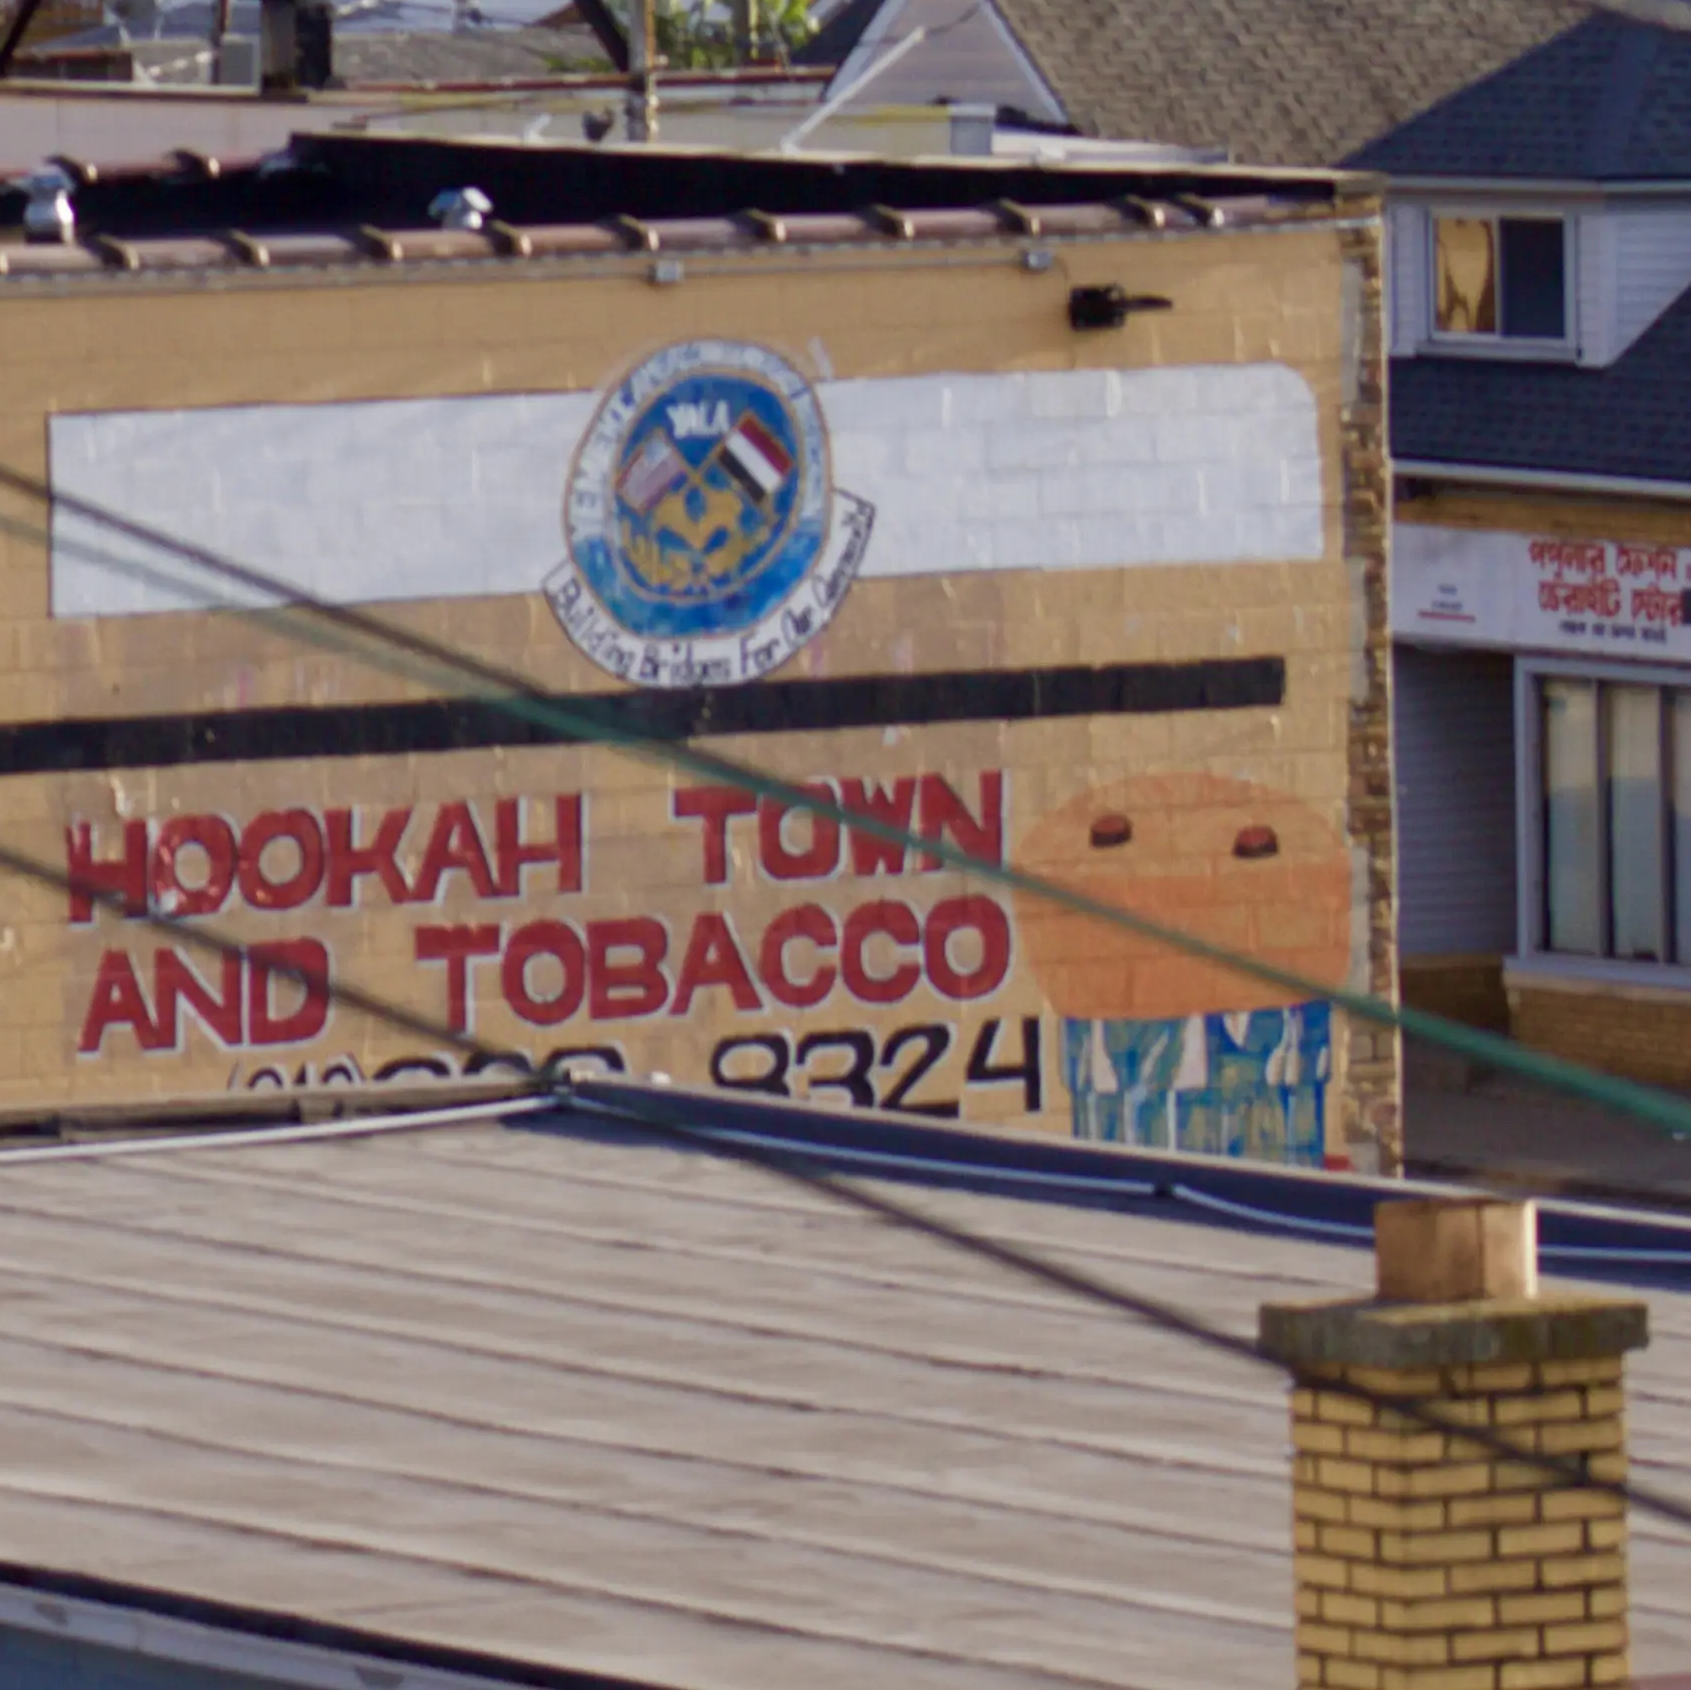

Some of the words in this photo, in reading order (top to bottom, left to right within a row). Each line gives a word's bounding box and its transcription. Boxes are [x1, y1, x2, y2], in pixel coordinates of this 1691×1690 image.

[739, 626, 781, 677] For
[65, 792, 582, 922] HOOKAH
[673, 771, 1005, 884] TOWN
[78, 937, 330, 1052] AND
[414, 898, 1009, 1027] TOBACCO
